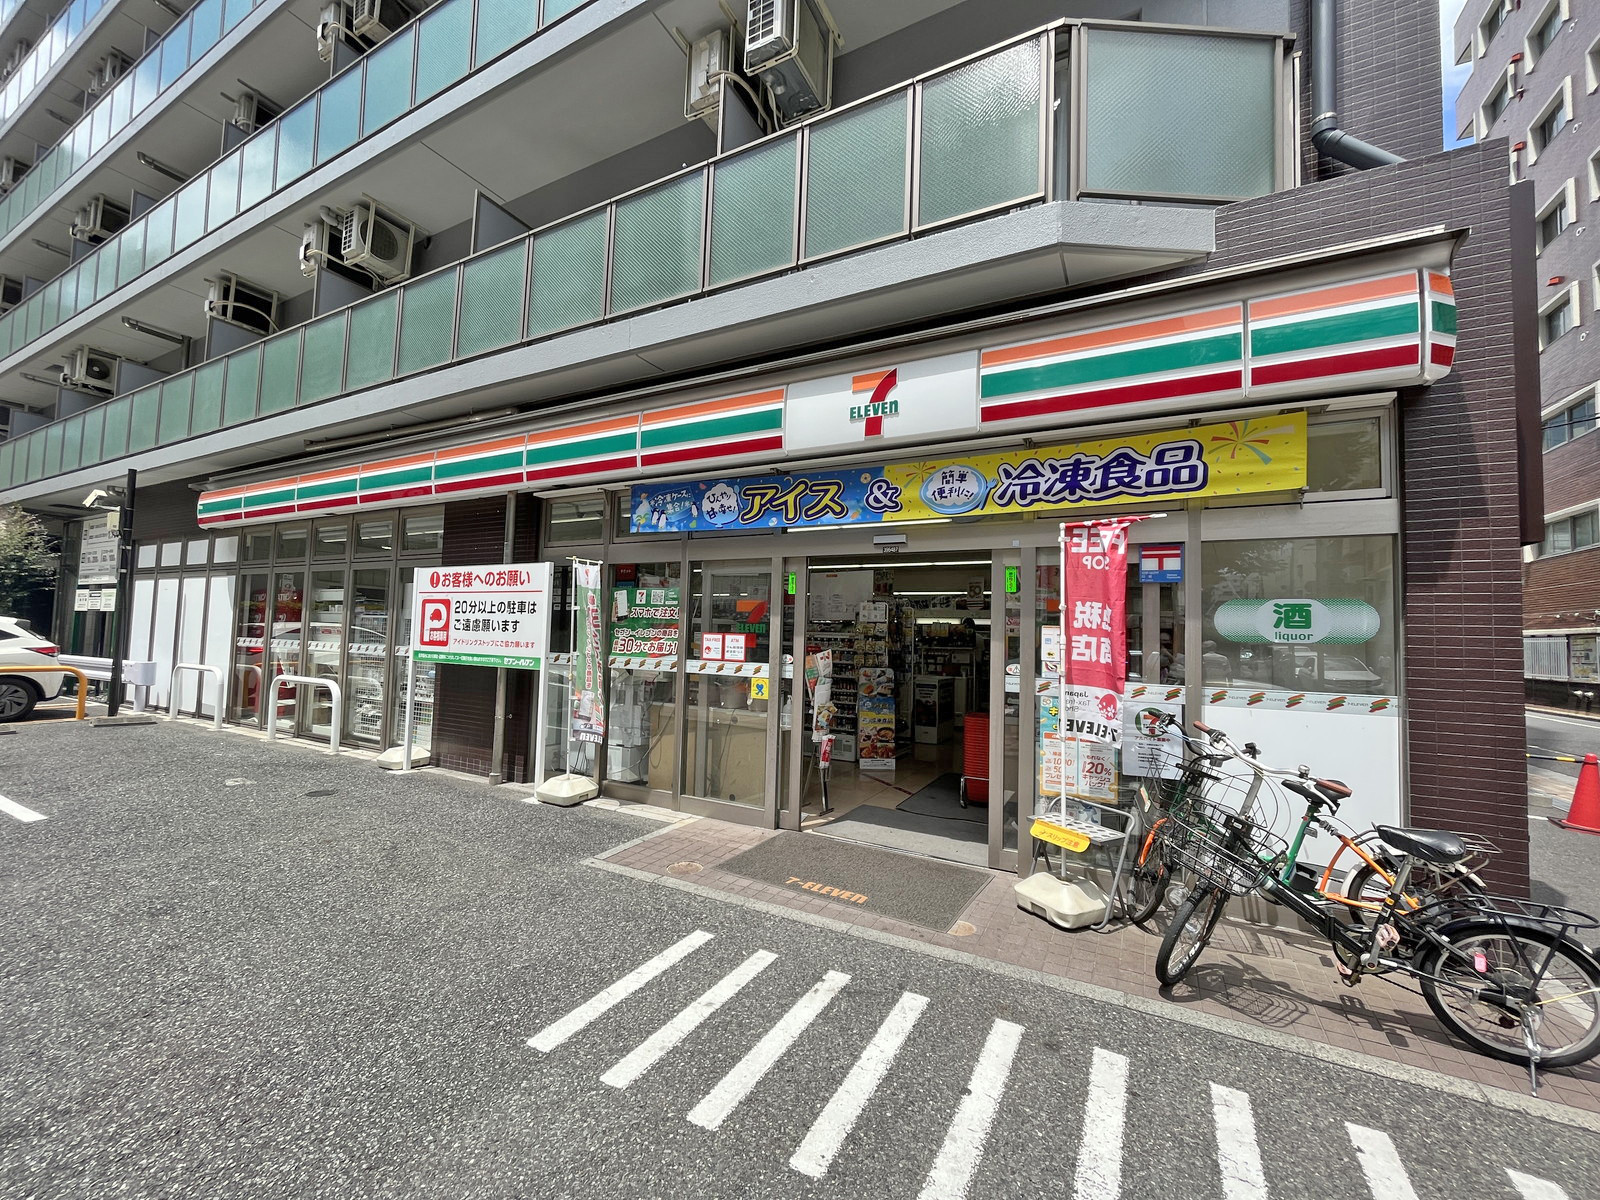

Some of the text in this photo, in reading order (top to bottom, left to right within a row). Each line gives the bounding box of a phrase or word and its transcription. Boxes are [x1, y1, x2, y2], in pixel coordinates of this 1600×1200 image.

[940, 470, 970, 486] 簡単
[995, 440, 1208, 507] 冷凍食品
[739, 478, 902, 526] アイス &
[441, 570, 531, 588] お客様へのお願い
[454, 600, 537, 615] 20分以上の駐車は
[1273, 603, 1312, 629] 酒
[453, 618, 520, 633] ご遠慮願います
[1275, 632, 1314, 641] liquor
